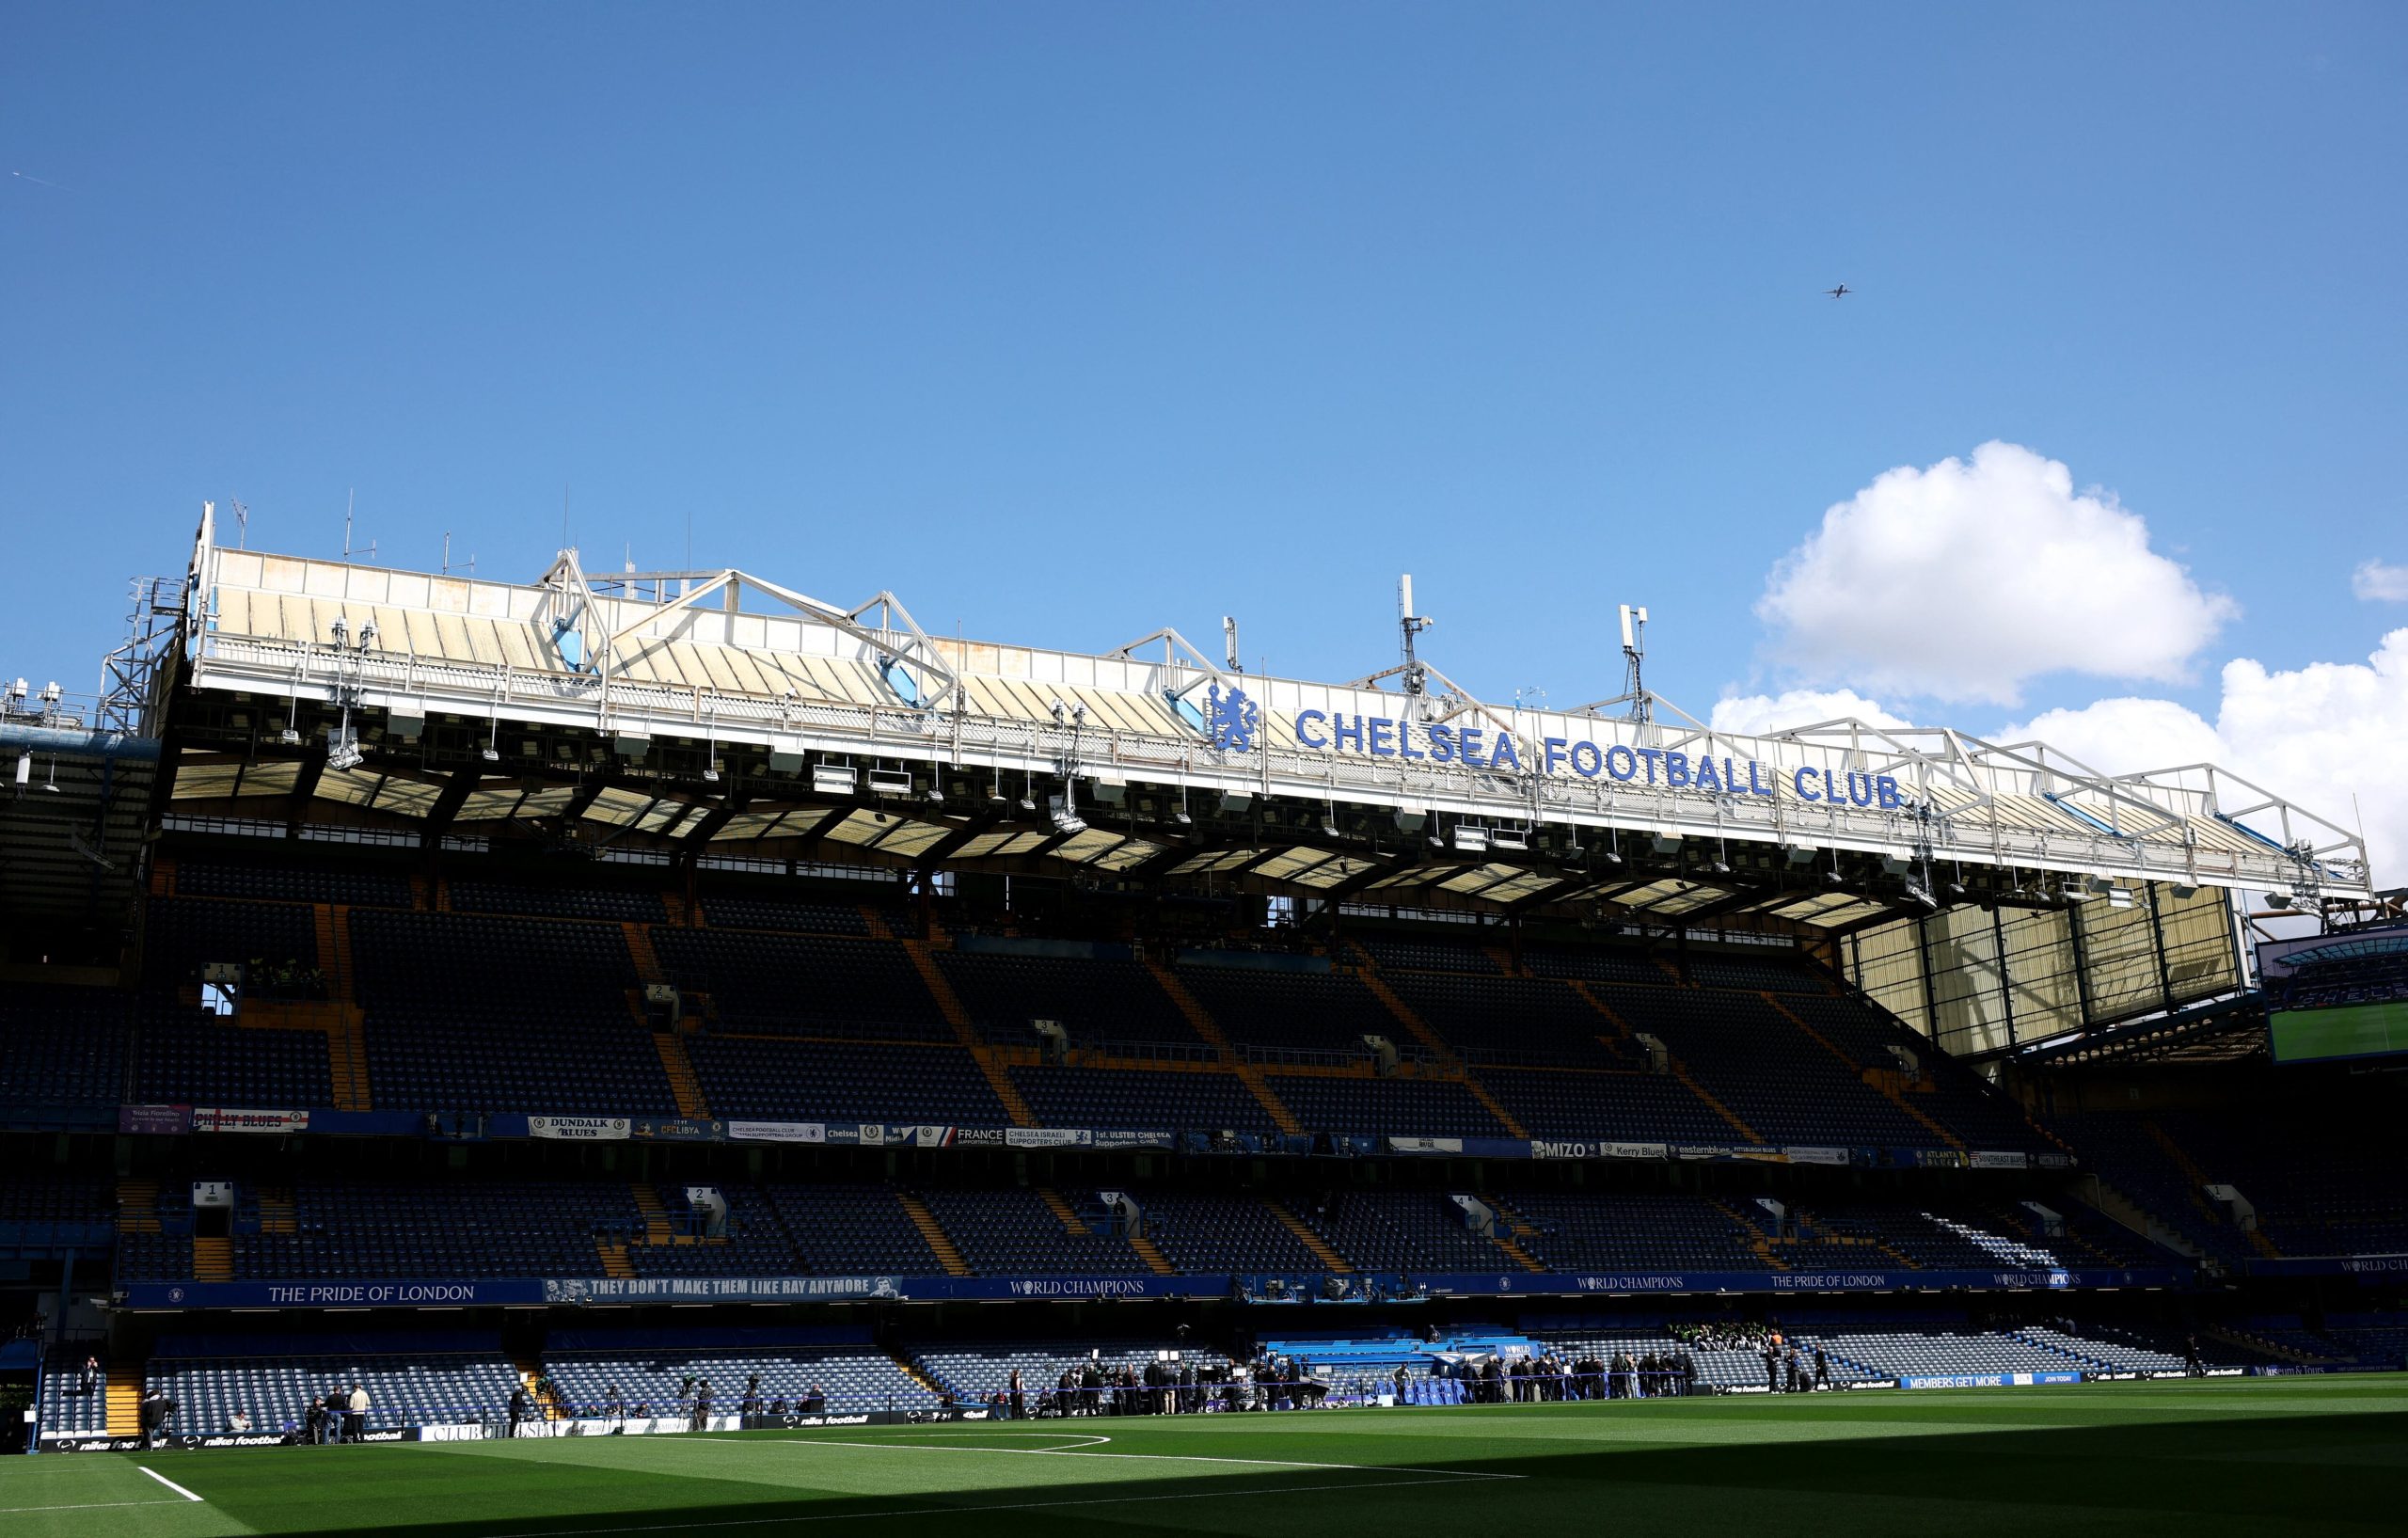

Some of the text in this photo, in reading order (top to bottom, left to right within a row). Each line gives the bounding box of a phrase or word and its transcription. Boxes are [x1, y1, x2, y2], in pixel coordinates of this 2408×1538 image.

[1296, 709, 1901, 809] CHELSEA FOOTBALL CLUB
[195, 1114, 282, 1128] PHILLY BLUES
[550, 1118, 608, 1128] DUNDALK
[561, 1129, 597, 1137] BLUES
[828, 1130, 859, 1138] Chelsea
[958, 1129, 1003, 1139] FRANCE
[1545, 1142, 1586, 1158] MIZO
[1617, 1147, 1665, 1157] Kerry Blues
[209, 1184, 215, 1195] 1
[696, 1188, 704, 1198] 2
[1106, 1193, 1113, 1203] 3
[1458, 1197, 1464, 1205] 4
[2340, 1260, 2386, 1272] WORLD
[1577, 1276, 1684, 1290] WORLD CHAMPIONS
[1771, 1275, 1885, 1287] THE PRIDE OF LONDON
[1994, 1274, 2082, 1286] WORLD CHAMPIONS
[591, 1278, 869, 1295] THEY DON'T MAKE THEM LIKE RAY ANYMORE
[1010, 1280, 1144, 1294] WORLD CHAMPIONS
[269, 1285, 475, 1302] THE PRIDE OF LONDON
[1504, 1345, 1530, 1354] WORLD
[2261, 1366, 2294, 1376] Museum
[2295, 1365, 2302, 1375] &
[2303, 1365, 2324, 1375] Tours
[1867, 1380, 1894, 1388] football
[1910, 1375, 2003, 1389] MEMBERS GET MORE
[825, 1414, 869, 1425] football
[435, 1426, 479, 1442] CLUB
[79, 1441, 111, 1451] nike
[204, 1436, 234, 1447] nike
